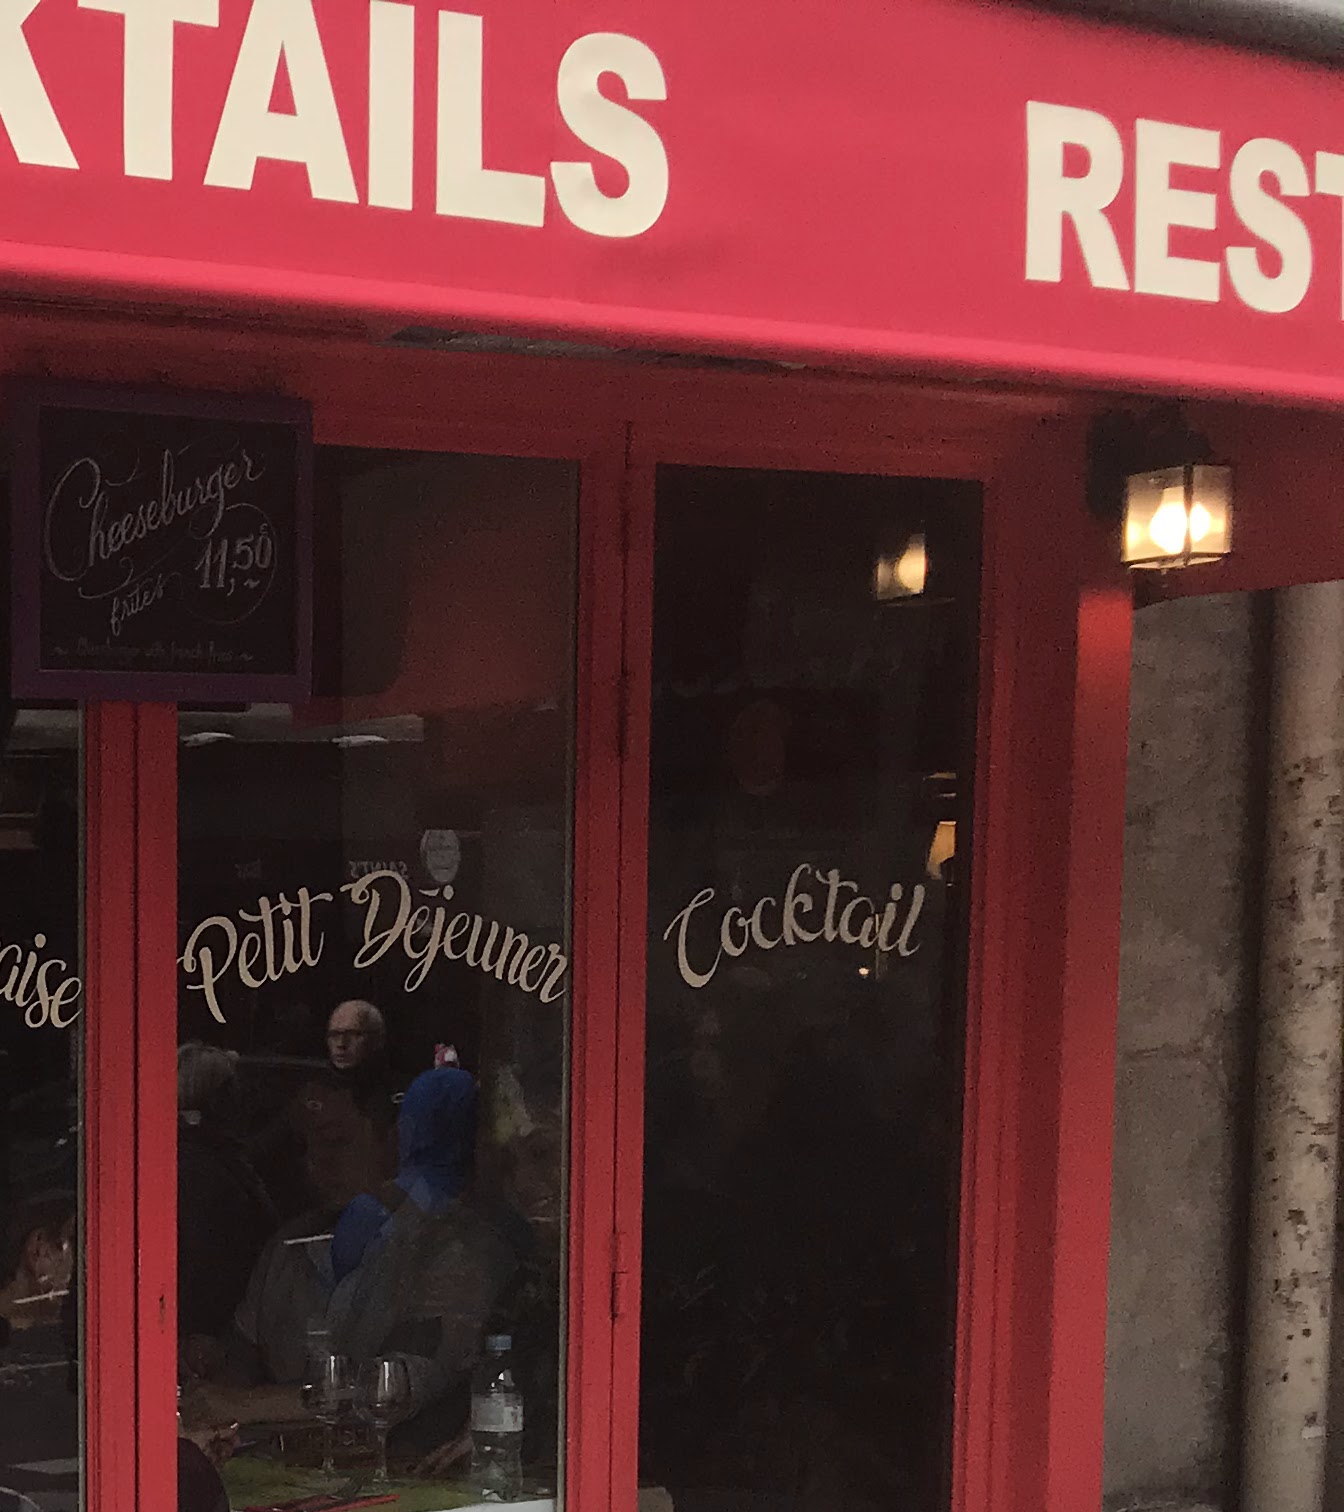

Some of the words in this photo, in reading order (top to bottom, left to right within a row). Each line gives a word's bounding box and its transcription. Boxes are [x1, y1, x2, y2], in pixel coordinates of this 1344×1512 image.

[177, 886, 333, 1023] Petit
[341, 870, 568, 1002] Déjeuner
[664, 863, 925, 988] Cocktail
